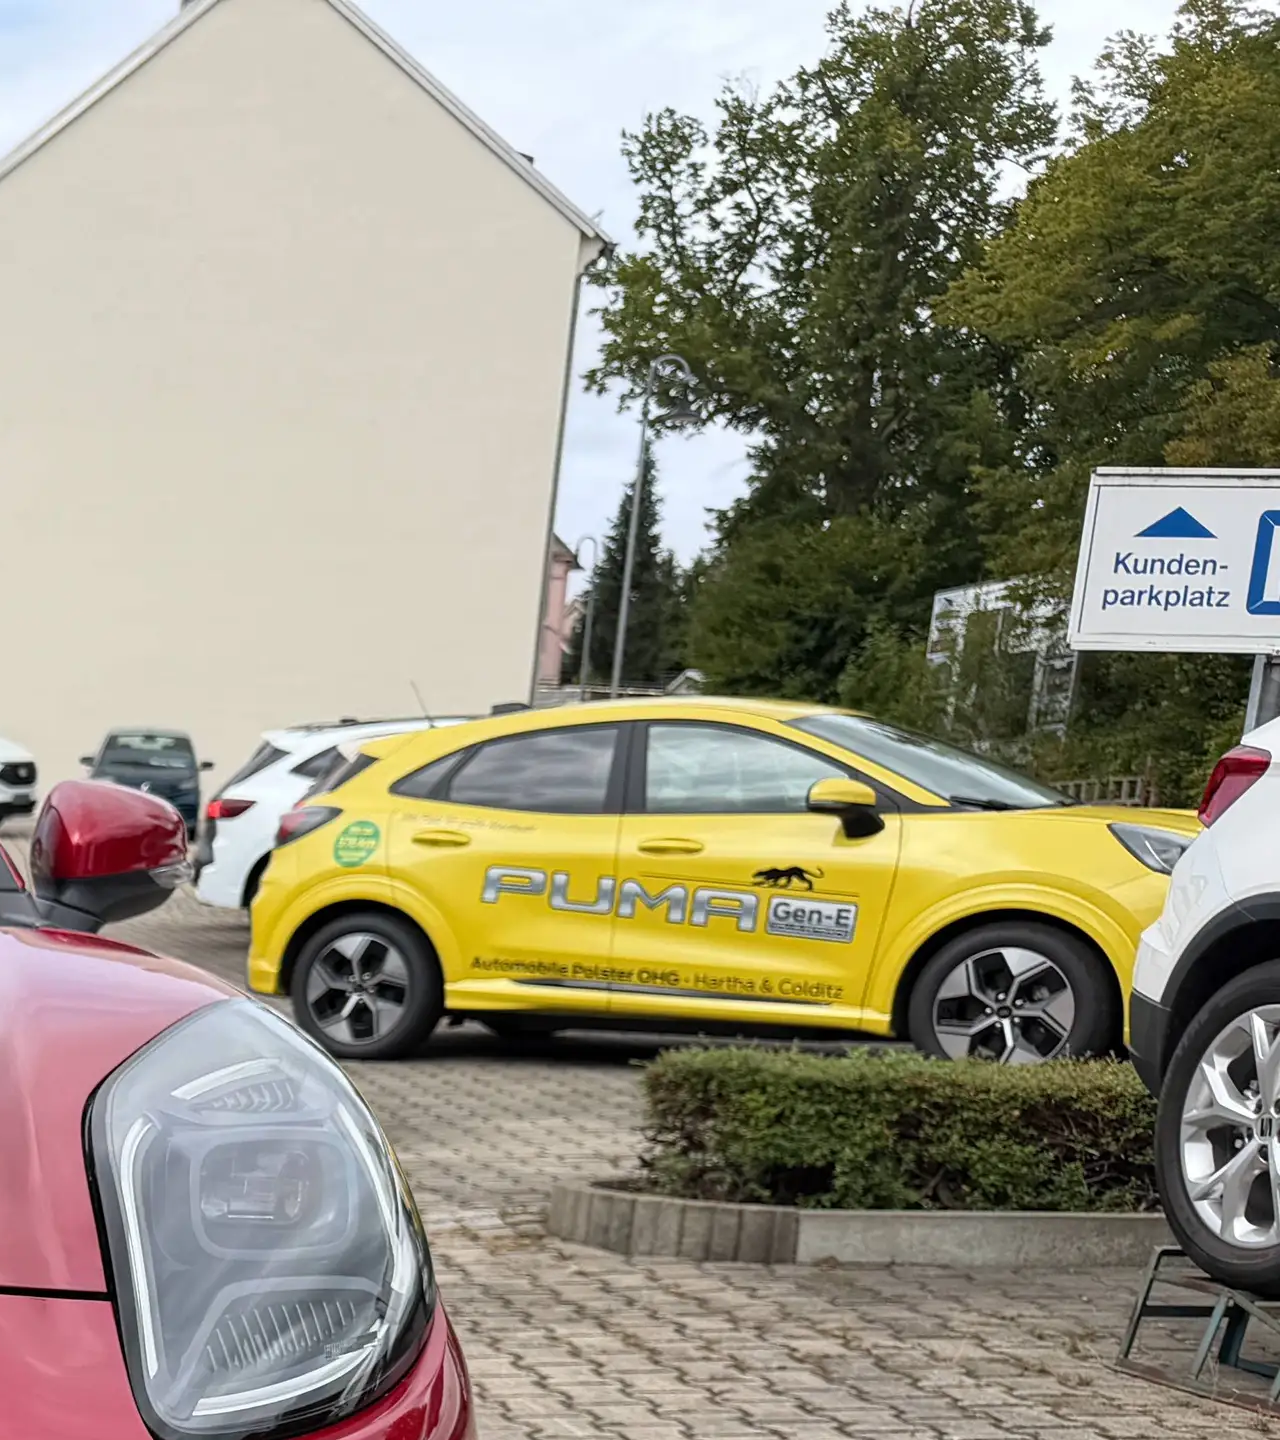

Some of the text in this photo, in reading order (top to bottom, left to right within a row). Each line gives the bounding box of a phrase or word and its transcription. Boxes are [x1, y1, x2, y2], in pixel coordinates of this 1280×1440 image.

[1114, 552, 1228, 576] Kunden-
[1102, 585, 1230, 611] parkplatz
[479, 865, 760, 933] PUMA
[773, 902, 852, 928] Gen-E
[471, 956, 844, 1000] Automobile Polster OHG Hartha & Colditz
